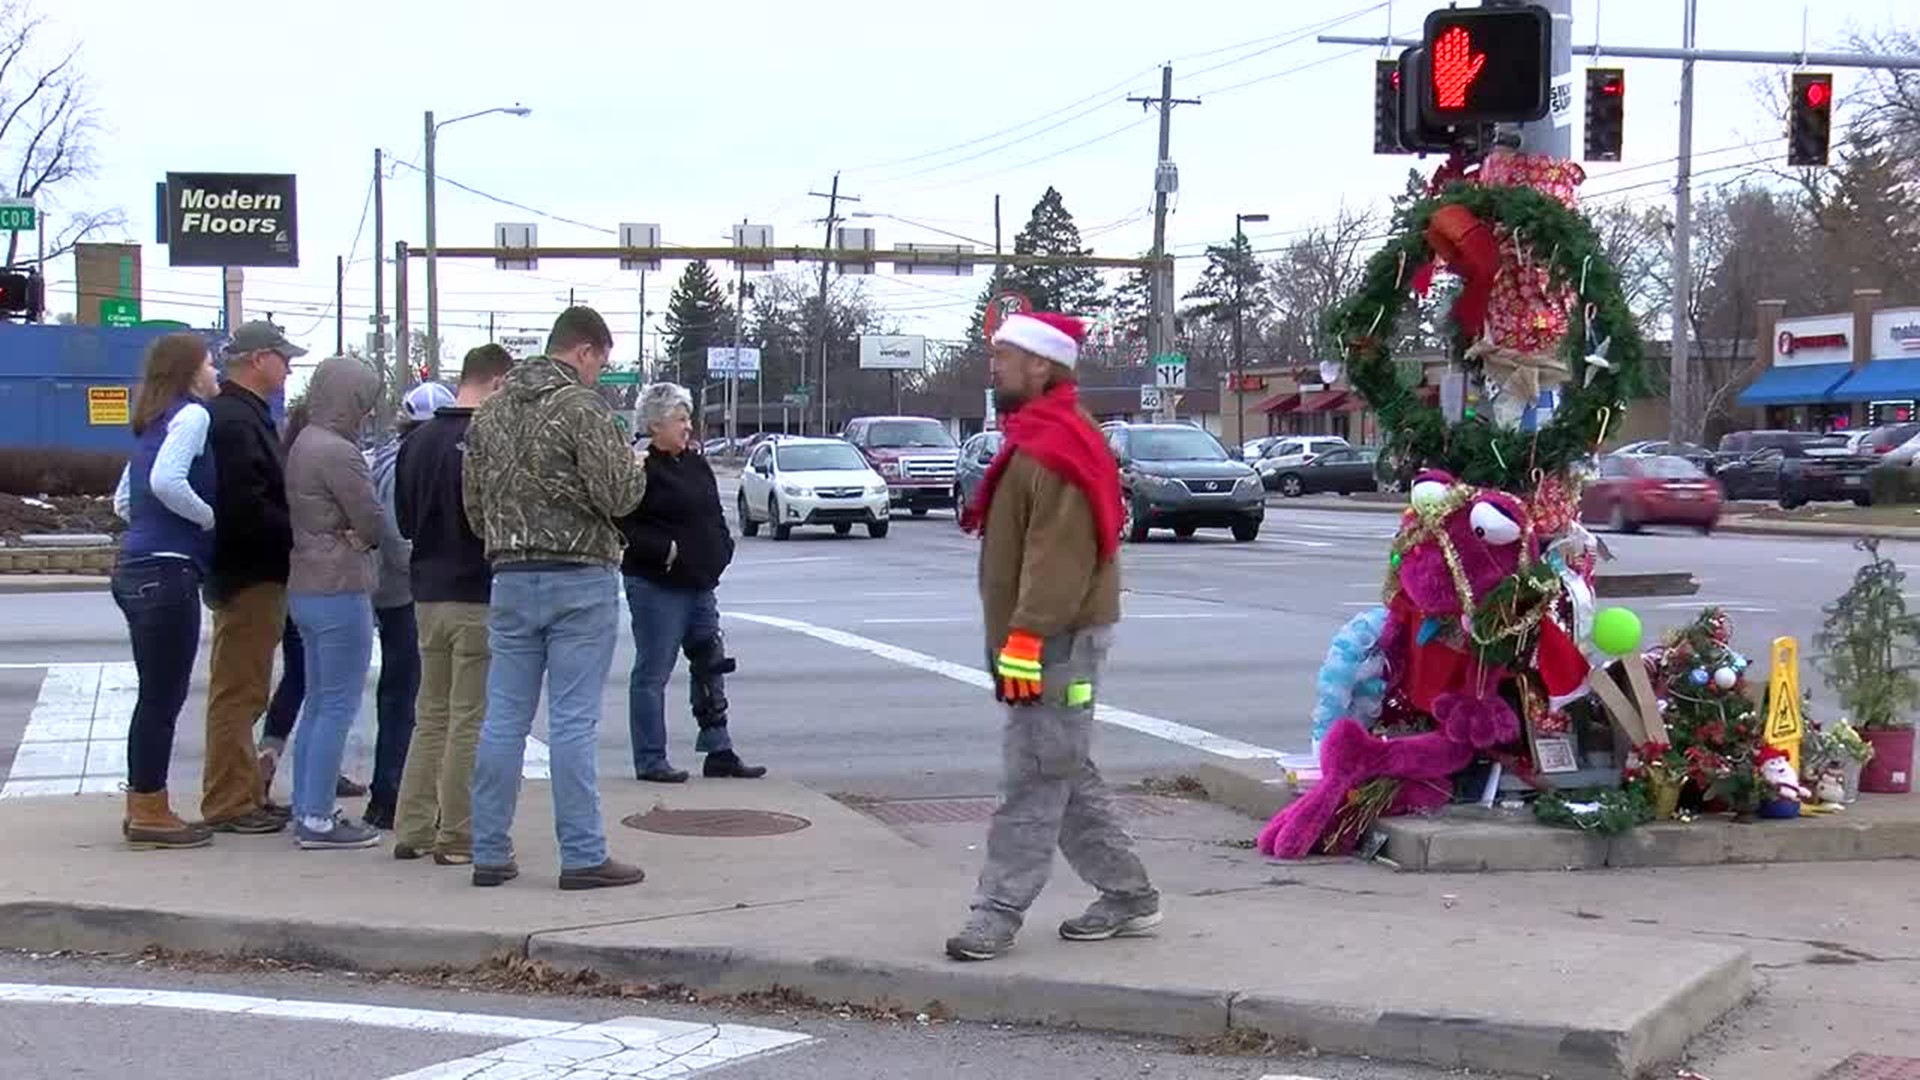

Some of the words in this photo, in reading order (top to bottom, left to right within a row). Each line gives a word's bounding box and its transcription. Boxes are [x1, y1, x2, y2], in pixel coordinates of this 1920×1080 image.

[180, 188, 282, 210] Modern
[1, 210, 30, 227] COR
[181, 212, 277, 234] Floors
[1142, 397, 1159, 407] 40
